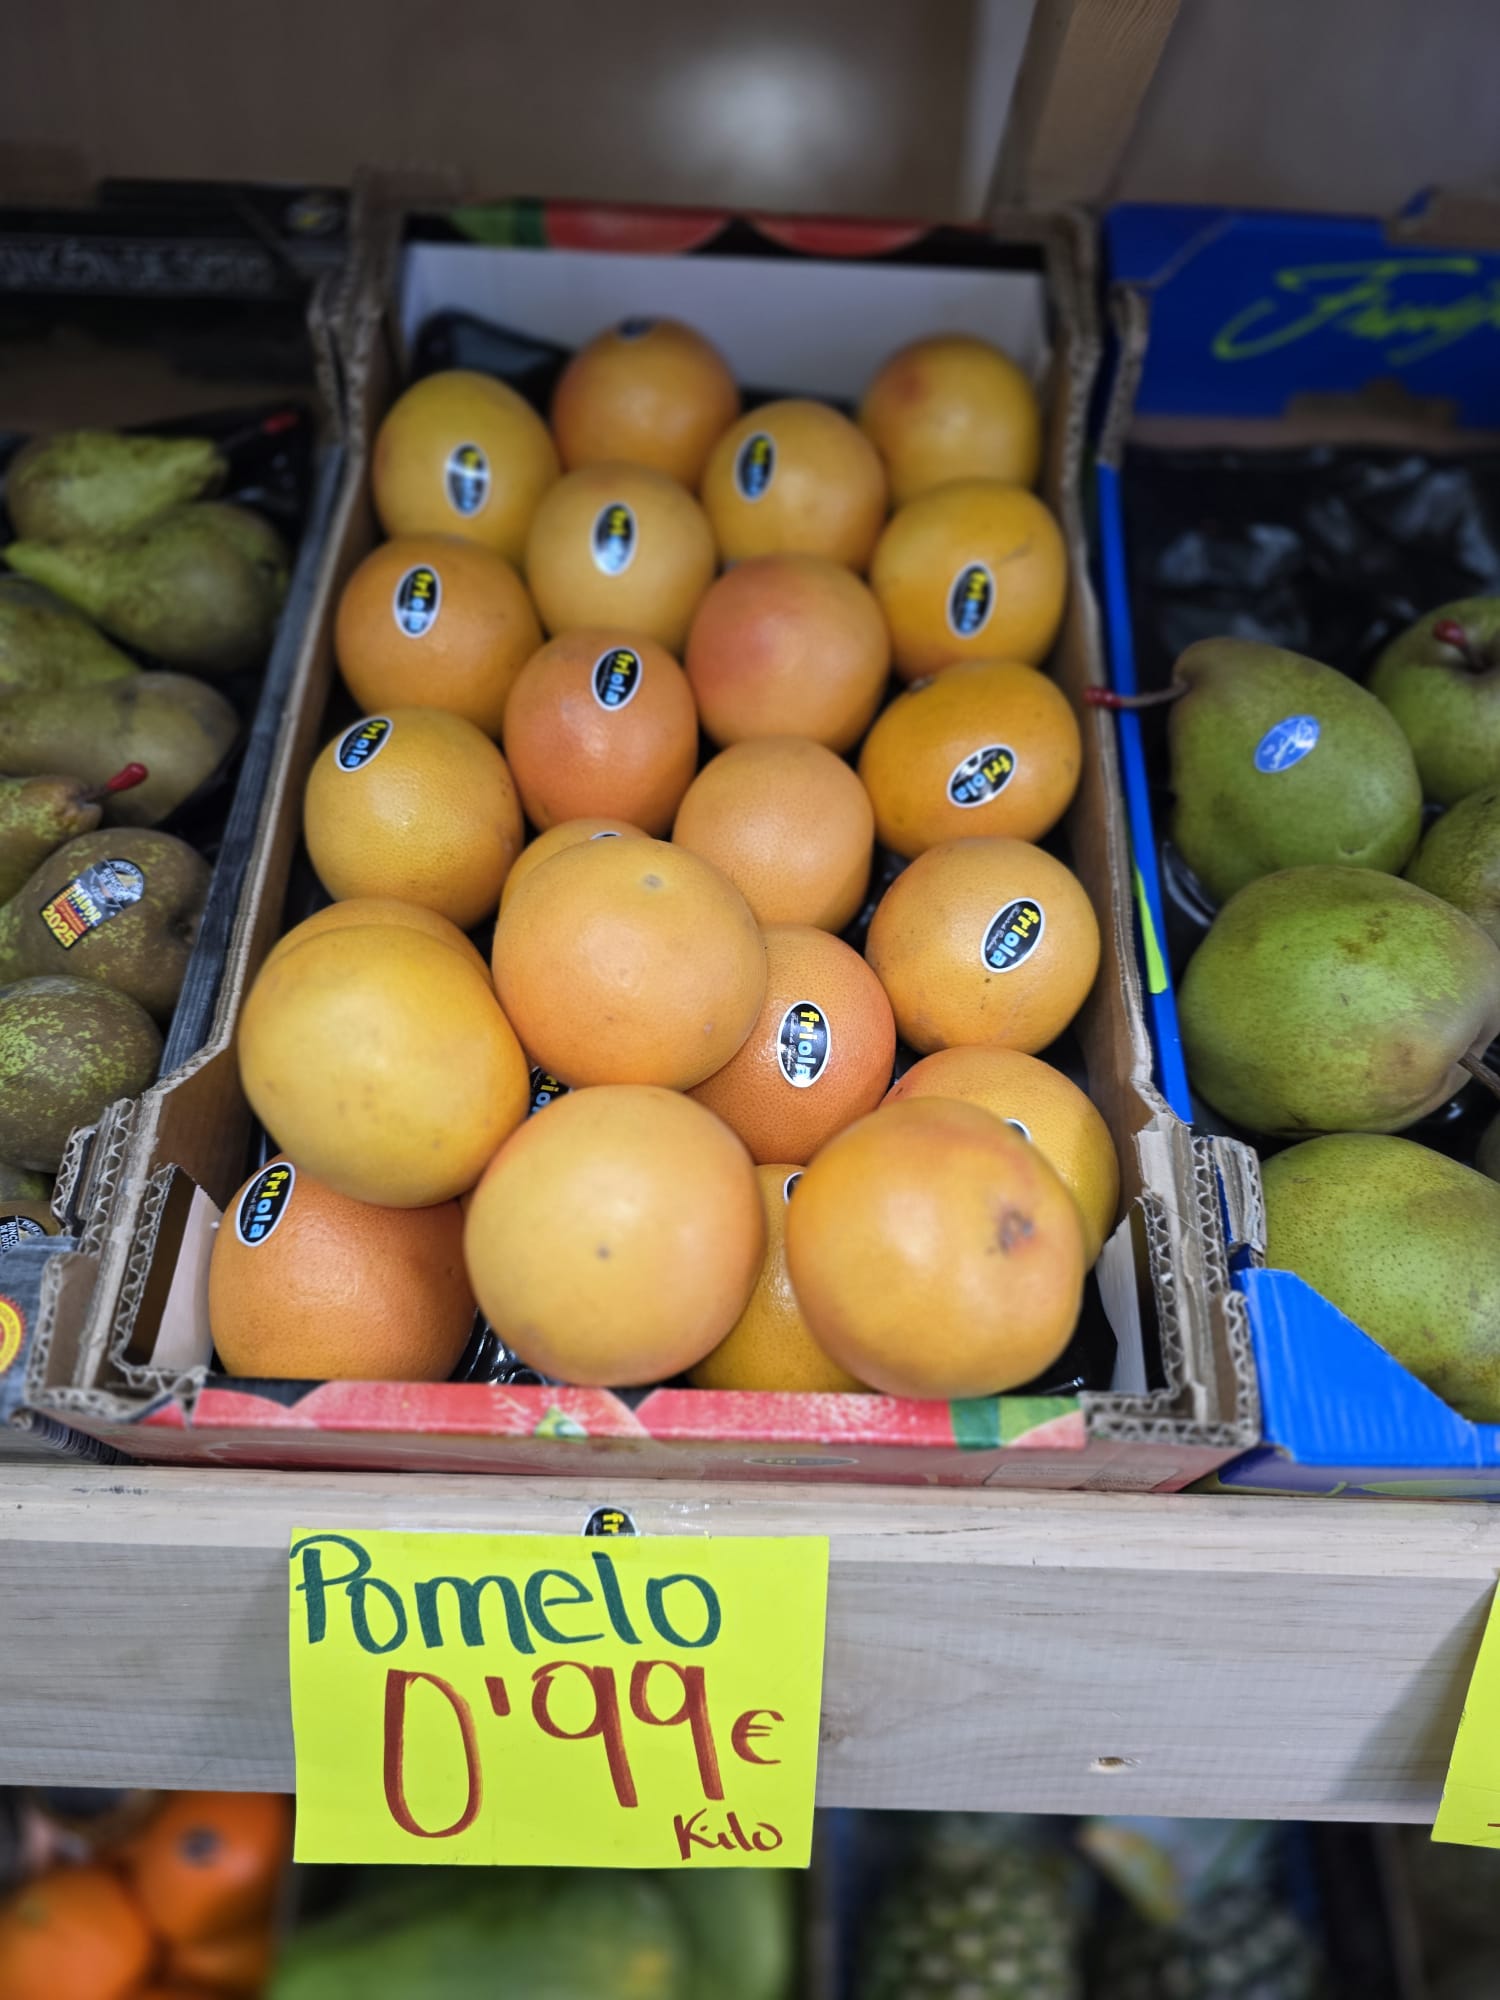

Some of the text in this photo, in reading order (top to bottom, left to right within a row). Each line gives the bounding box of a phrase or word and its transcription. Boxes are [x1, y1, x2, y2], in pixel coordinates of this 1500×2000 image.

[605, 653, 635, 704] friola
[346, 722, 387, 766] friola
[955, 754, 1011, 801] friola
[41, 904, 79, 948] 2025
[71, 886, 102, 922] SABOR
[989, 908, 1040, 967] friola
[793, 1011, 820, 1080] friola
[249, 1171, 289, 1238] friola
[7, 1221, 18, 1246] RINCO
[289, 1534, 722, 1655] Pomelo
[673, 1809, 783, 1860] Kilo
